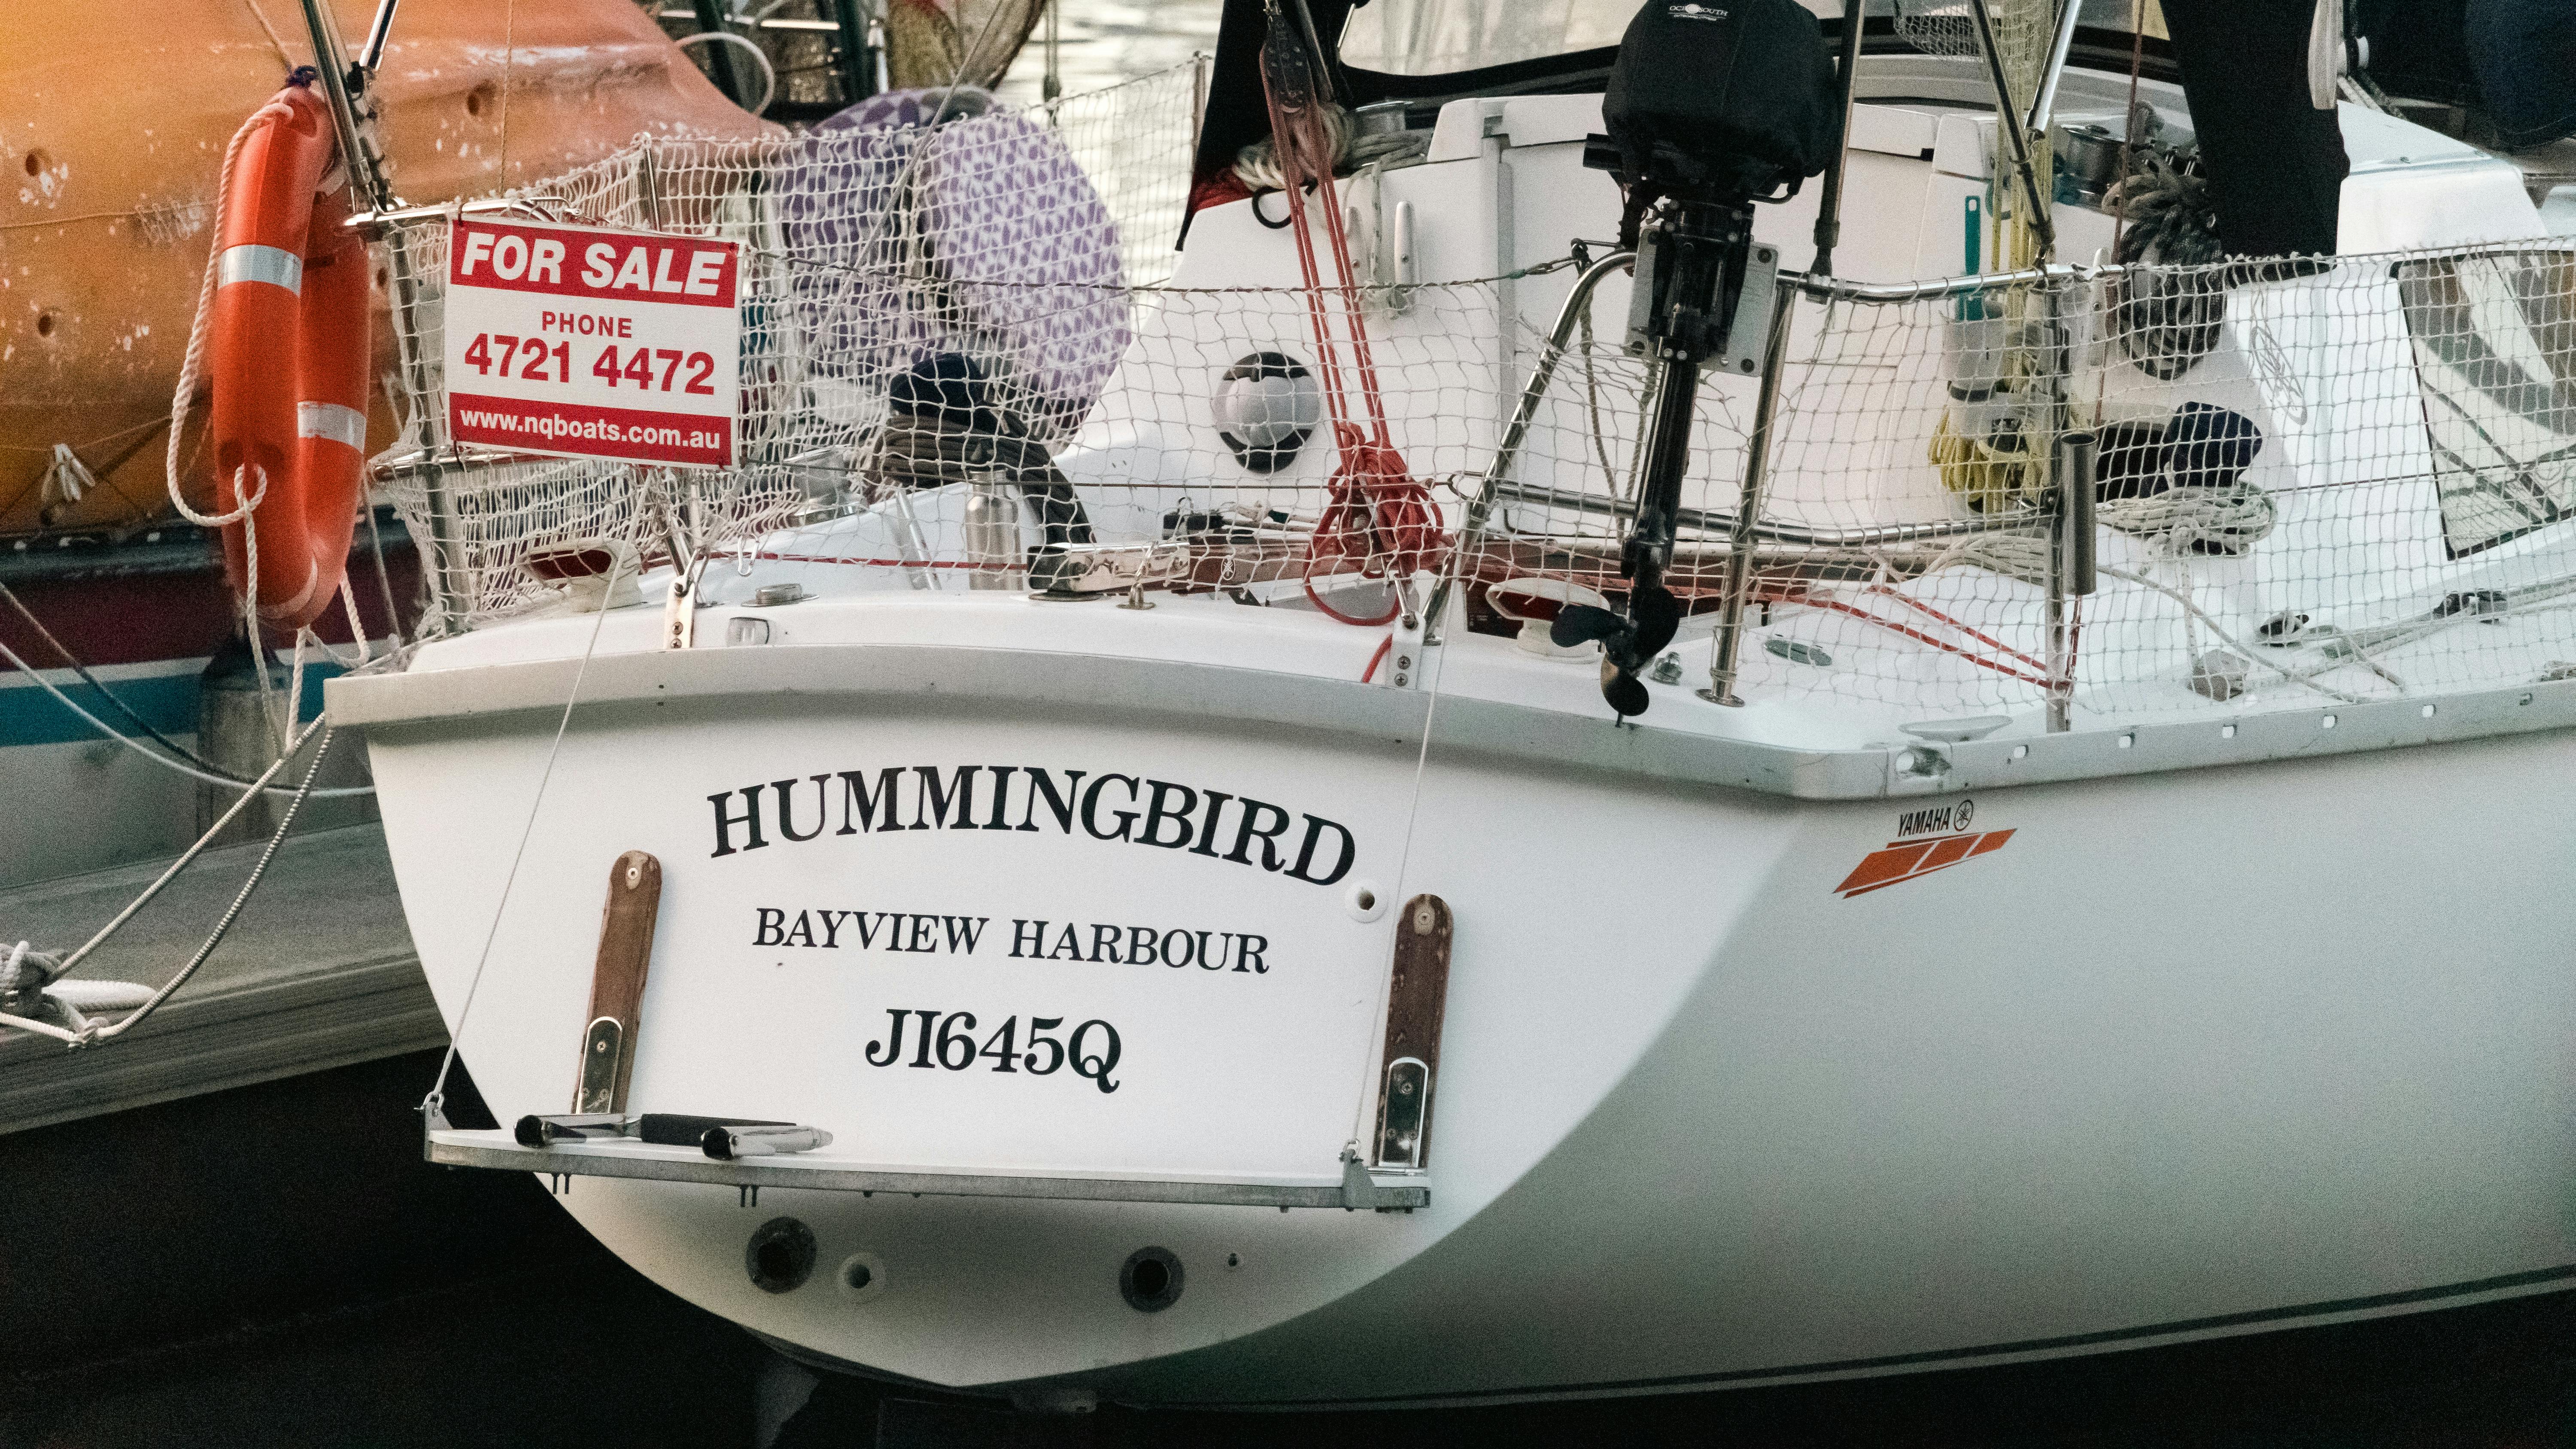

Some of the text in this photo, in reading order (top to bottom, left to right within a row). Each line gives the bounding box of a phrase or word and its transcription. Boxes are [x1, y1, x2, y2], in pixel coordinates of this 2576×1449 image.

[461, 232, 726, 296] FOR SALE
[542, 311, 632, 338] PHONE
[465, 333, 715, 395] 4721 4472
[460, 408, 720, 449] www.nqboats.com.au
[707, 765, 1356, 886] HUMMINGBIRD
[1898, 807, 1952, 837] YAMAHA
[752, 908, 1270, 975] BAYVIEW HARBOUR
[865, 1009, 1121, 1094] JI645Q
